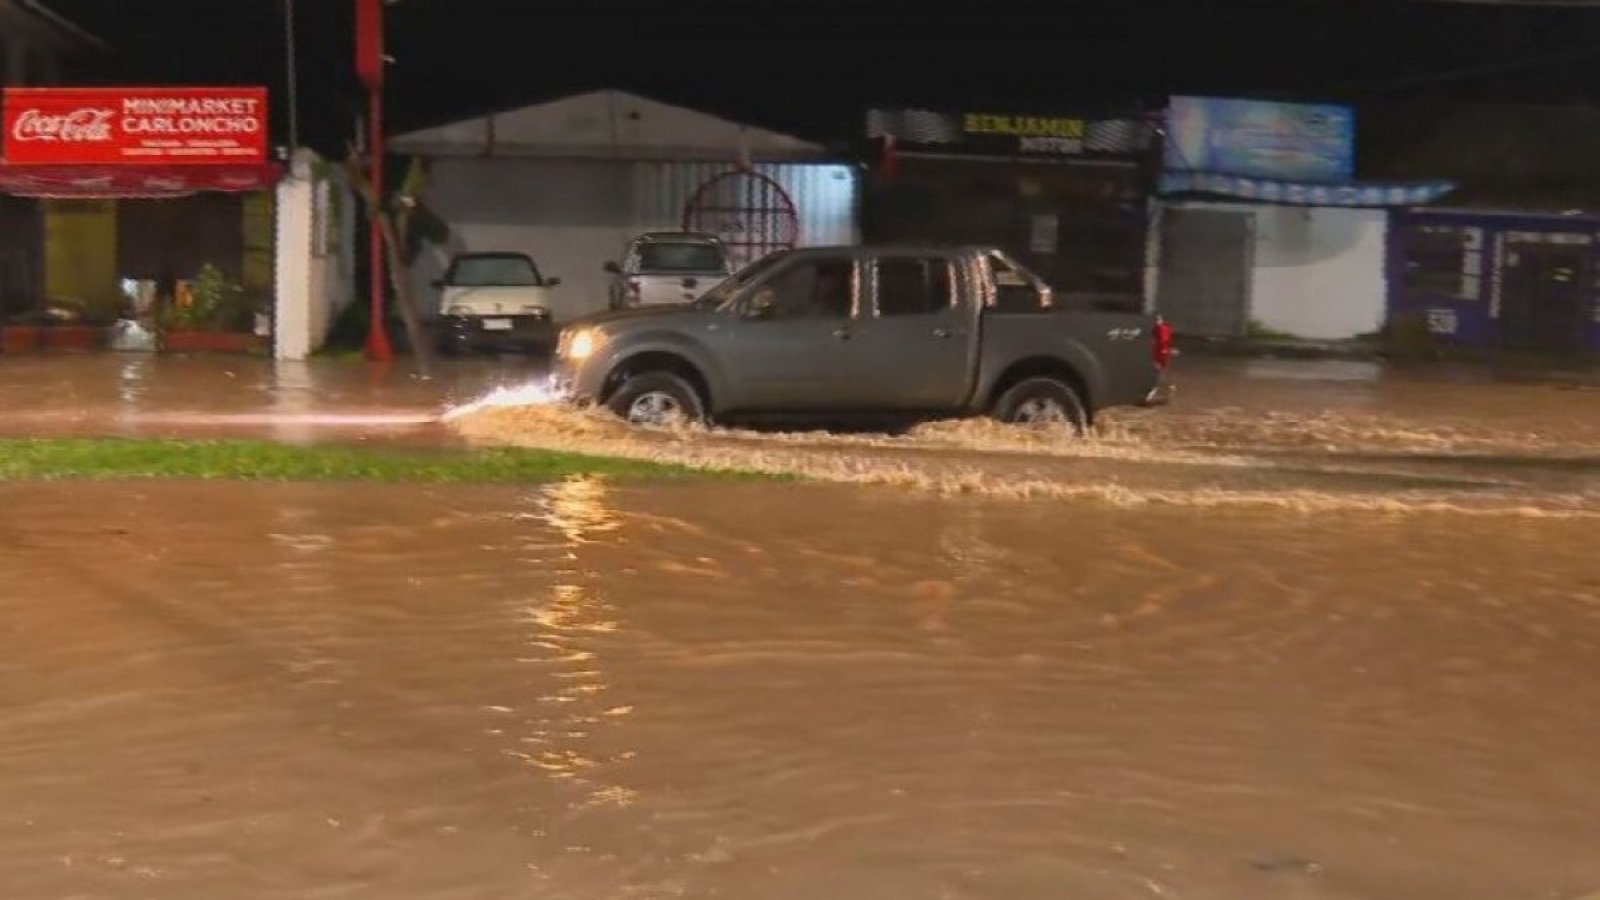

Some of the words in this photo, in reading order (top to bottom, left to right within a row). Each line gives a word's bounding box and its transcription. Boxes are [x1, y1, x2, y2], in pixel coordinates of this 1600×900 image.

[123, 98, 257, 115] MINIMARKET
[123, 118, 258, 133] CARLONCHO
[964, 113, 1083, 137] BENJAMIN
